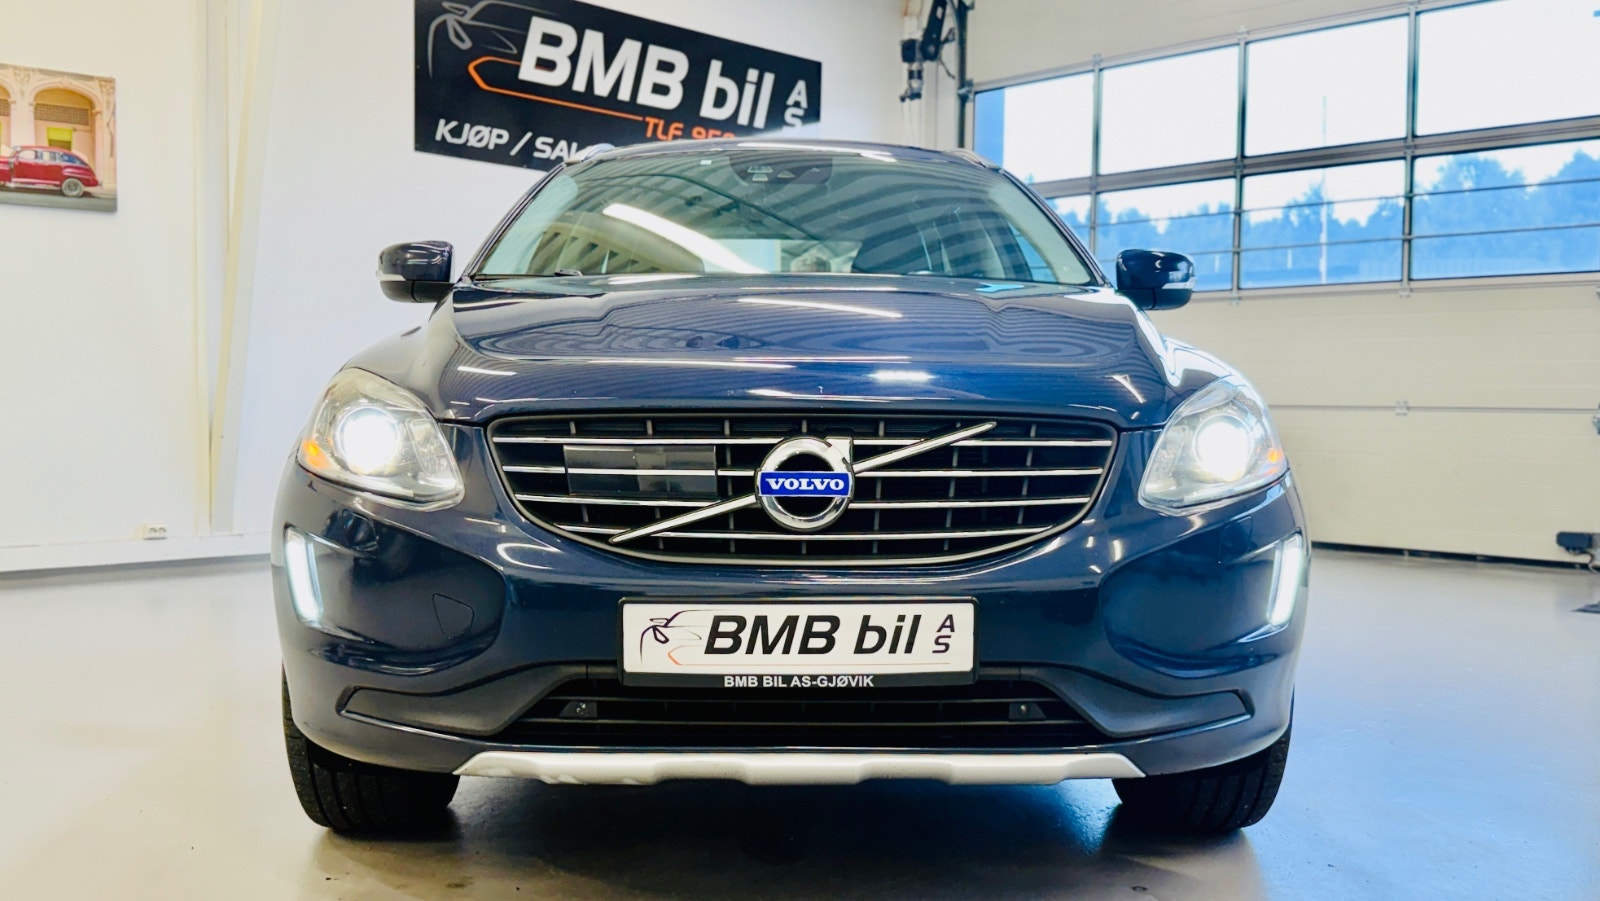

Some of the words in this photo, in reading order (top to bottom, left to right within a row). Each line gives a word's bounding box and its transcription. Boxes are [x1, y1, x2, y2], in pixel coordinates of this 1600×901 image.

[518, 16, 690, 111] BMB
[699, 59, 775, 129] bil
[434, 118, 510, 150] KJØP
[645, 116, 685, 140] TLF
[765, 478, 845, 490] VOLVO
[704, 615, 841, 655] BMB
[853, 614, 922, 655] bil
[724, 675, 758, 688] BMB
[762, 675, 787, 688] BIL
[790, 675, 874, 688] AS-GJØVIK
